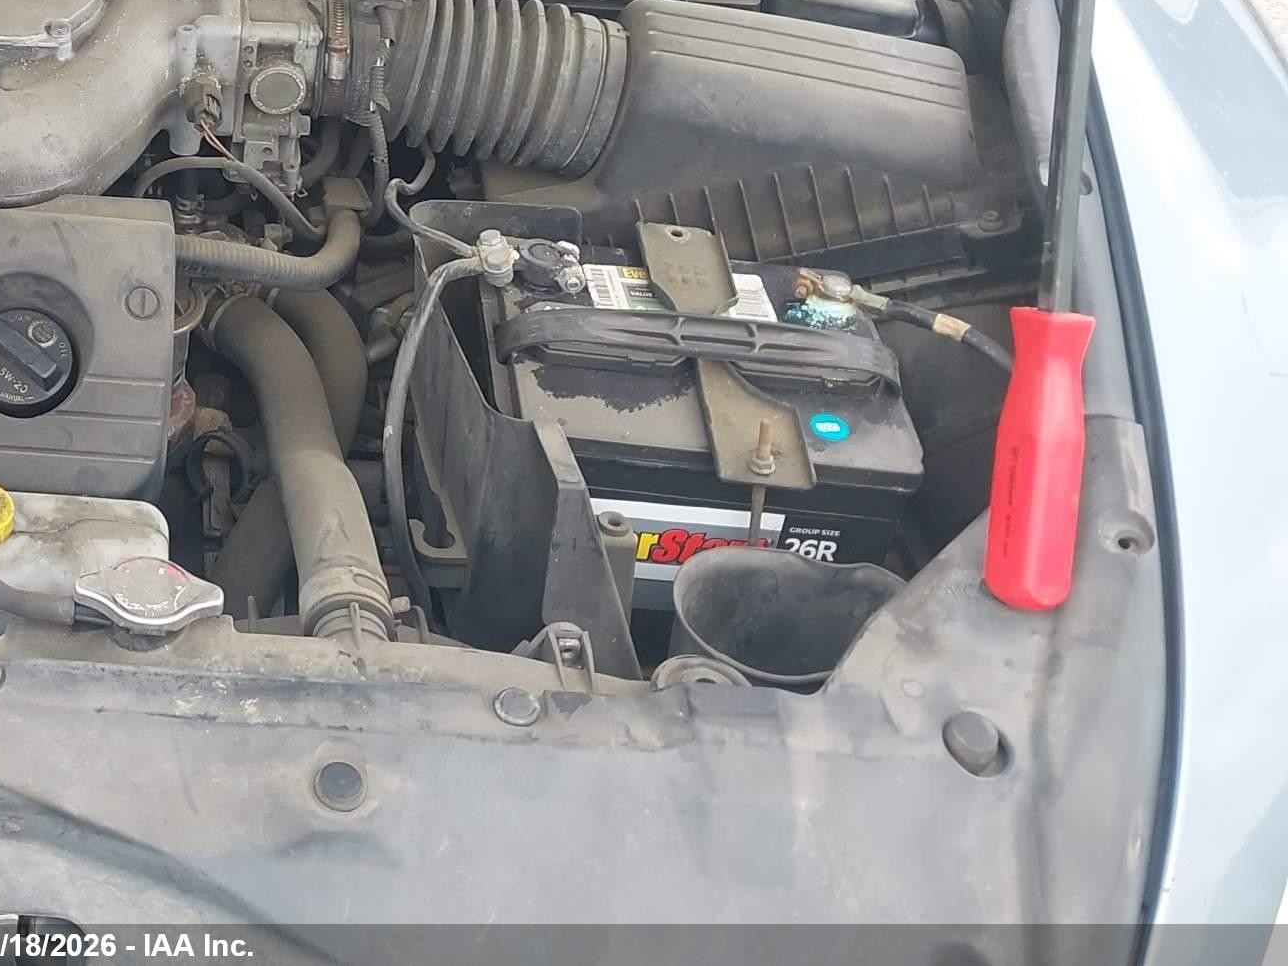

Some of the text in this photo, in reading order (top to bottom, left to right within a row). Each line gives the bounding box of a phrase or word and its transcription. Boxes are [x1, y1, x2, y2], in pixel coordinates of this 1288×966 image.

[622, 267, 647, 279] Eve
[789, 526, 841, 537] GROUP SIZE
[785, 537, 838, 562] 26R
